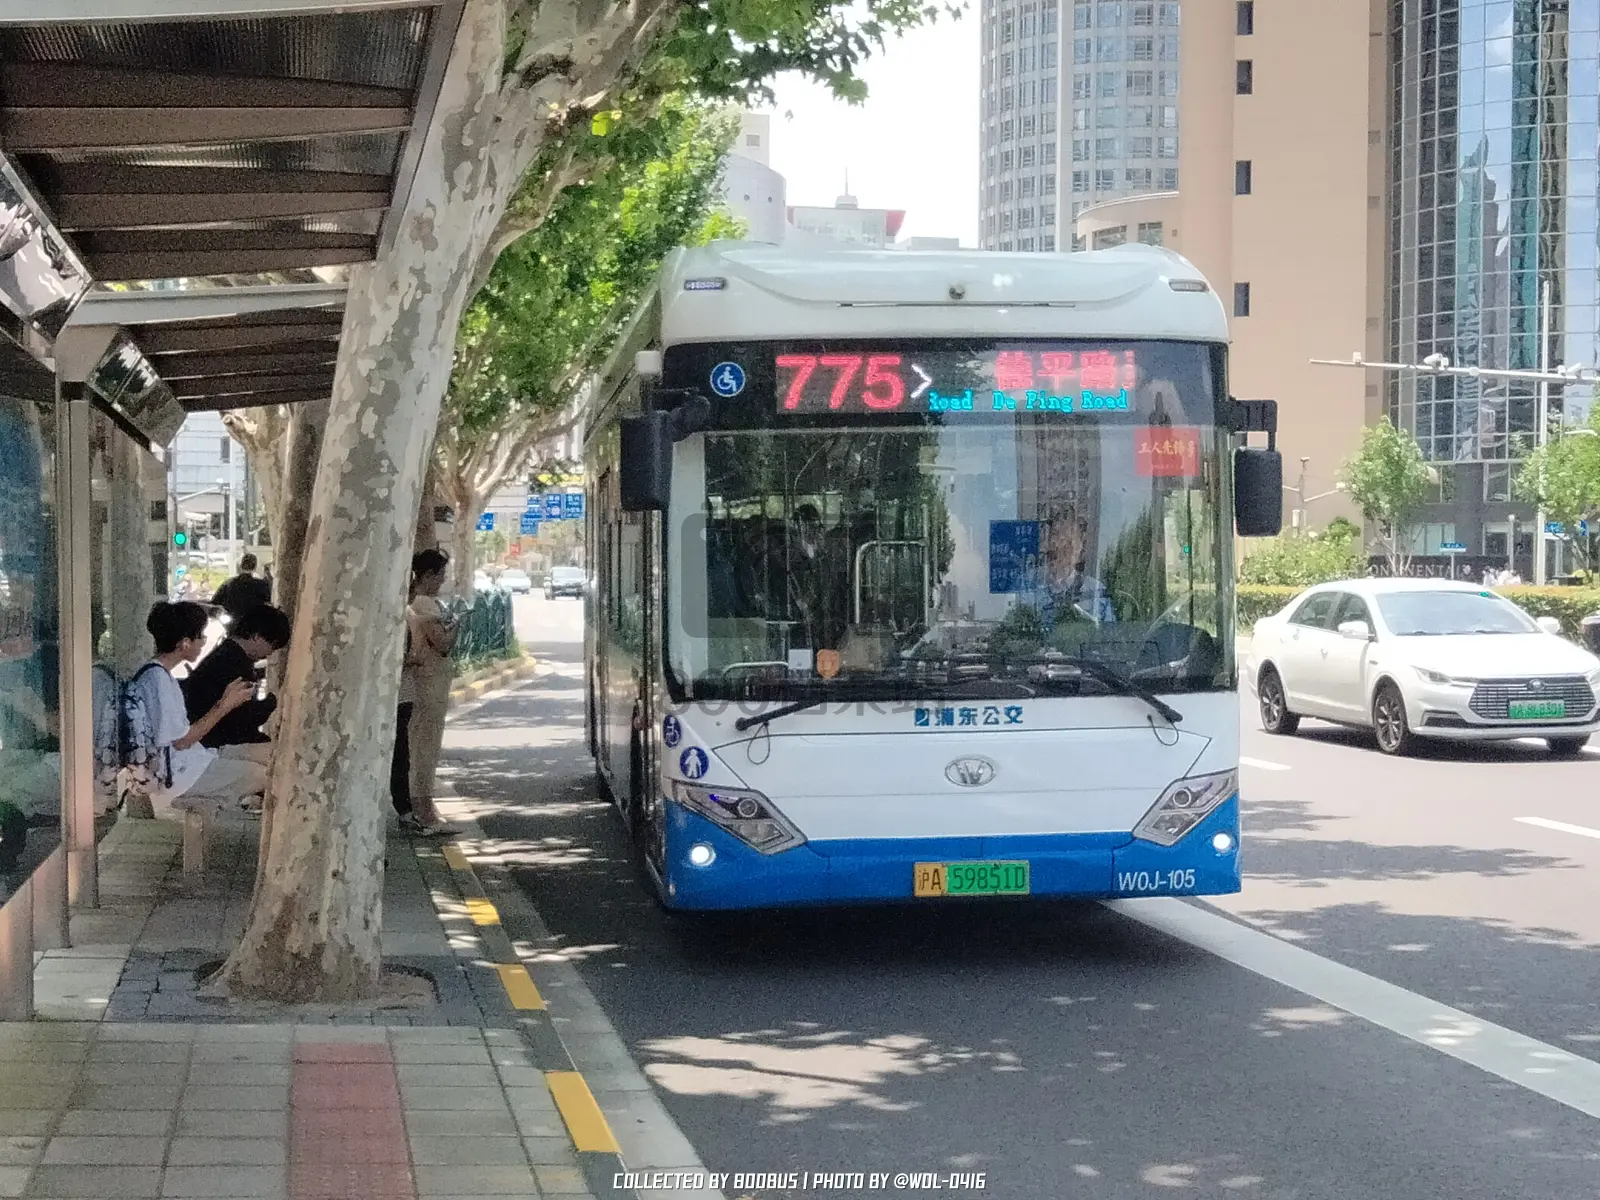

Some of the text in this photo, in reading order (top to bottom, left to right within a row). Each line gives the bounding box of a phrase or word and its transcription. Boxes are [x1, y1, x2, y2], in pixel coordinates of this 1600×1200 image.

[775, 354, 906, 411] 775
[993, 389, 1016, 411] De
[1026, 388, 1074, 412] Ping
[1081, 388, 1129, 410] Road
[934, 705, 1024, 727] 浦东公交
